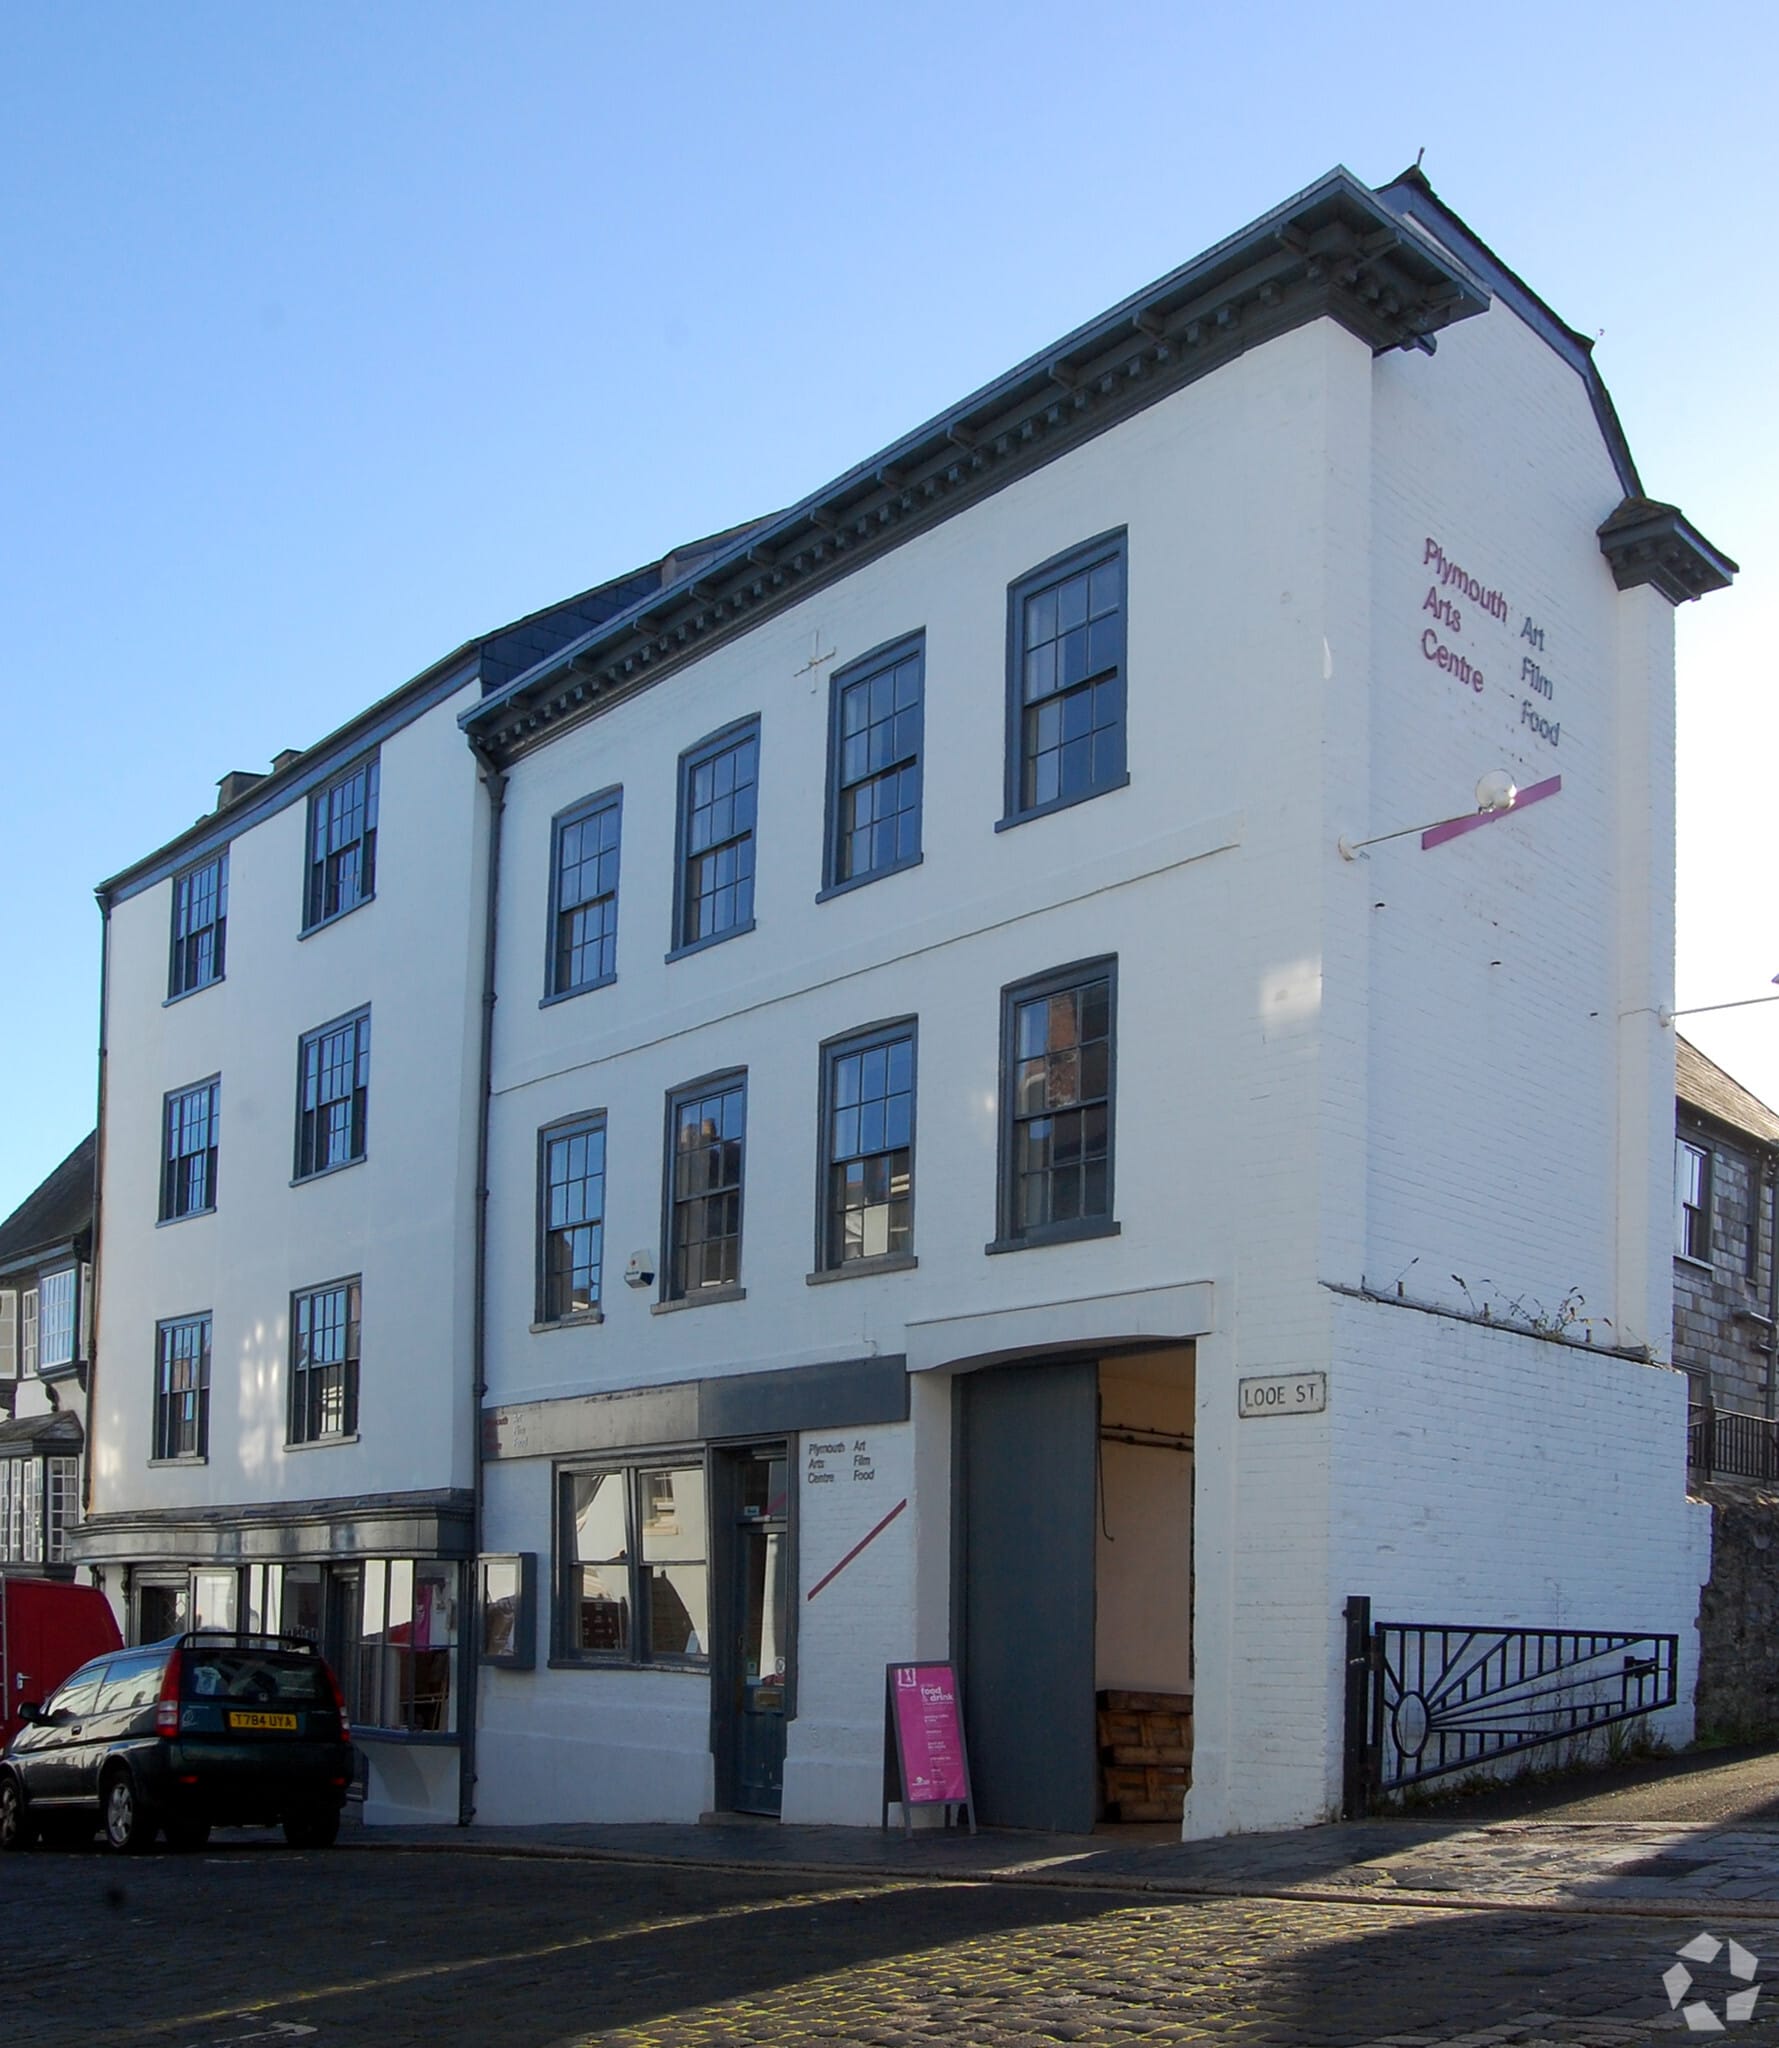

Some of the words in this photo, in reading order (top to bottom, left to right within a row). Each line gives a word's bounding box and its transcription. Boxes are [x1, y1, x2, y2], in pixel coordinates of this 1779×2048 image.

[1423, 537, 1508, 623] Plymouth
[1422, 586, 1461, 632] Arts
[1520, 617, 1545, 651] Art
[1421, 628, 1484, 692] Centre
[1521, 656, 1553, 701] Film
[1521, 700, 1560, 746] Food
[1245, 1386, 1286, 1407] LOOE
[808, 1442, 845, 1456] Plymouth
[853, 1440, 866, 1452] Art
[808, 1459, 825, 1470] Arts
[853, 1455, 871, 1467] Film
[808, 1473, 834, 1484] Centre
[853, 1469, 875, 1481] Food
[921, 1686, 942, 1695] food
[930, 1693, 954, 1702] drink
[269, 1715, 294, 1728] UYA
